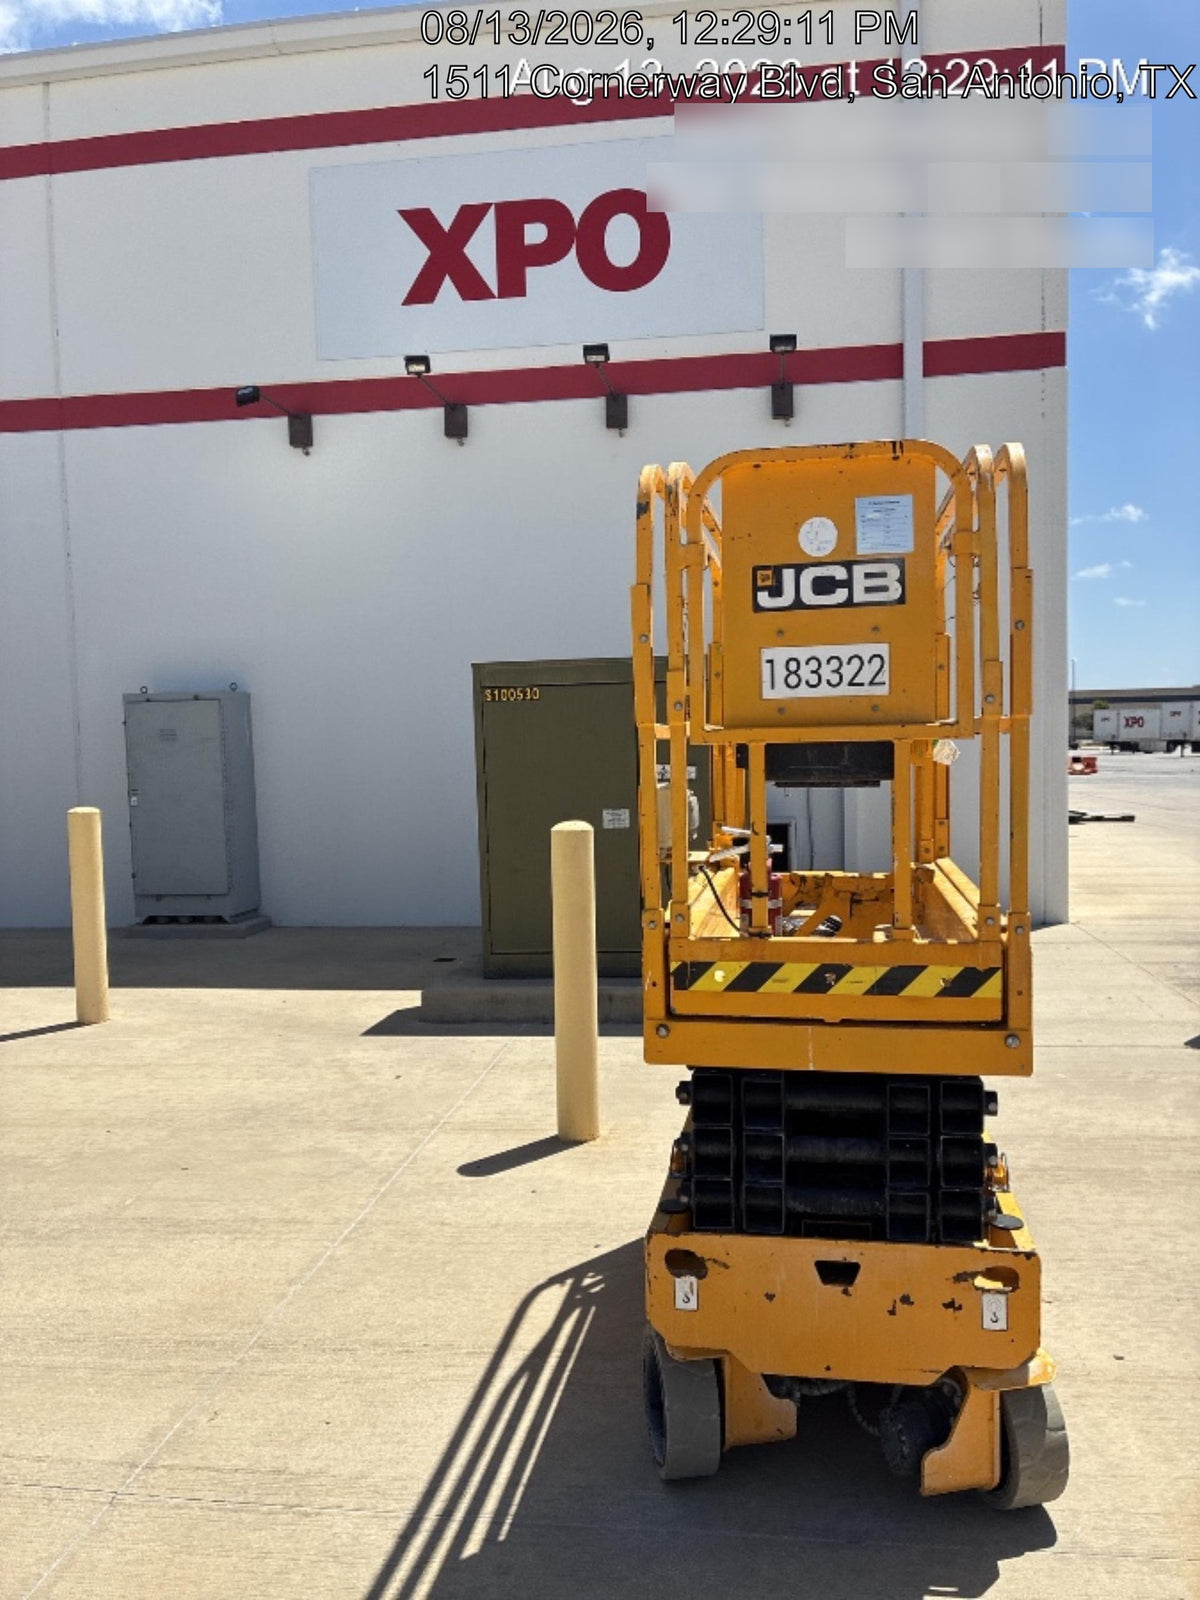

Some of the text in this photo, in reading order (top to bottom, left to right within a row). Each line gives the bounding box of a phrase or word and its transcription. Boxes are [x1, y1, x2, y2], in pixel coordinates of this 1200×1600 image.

[397, 188, 671, 306] XPO
[756, 562, 903, 609] JCB
[764, 653, 886, 690] 183322
[1124, 716, 1145, 728] XPO
